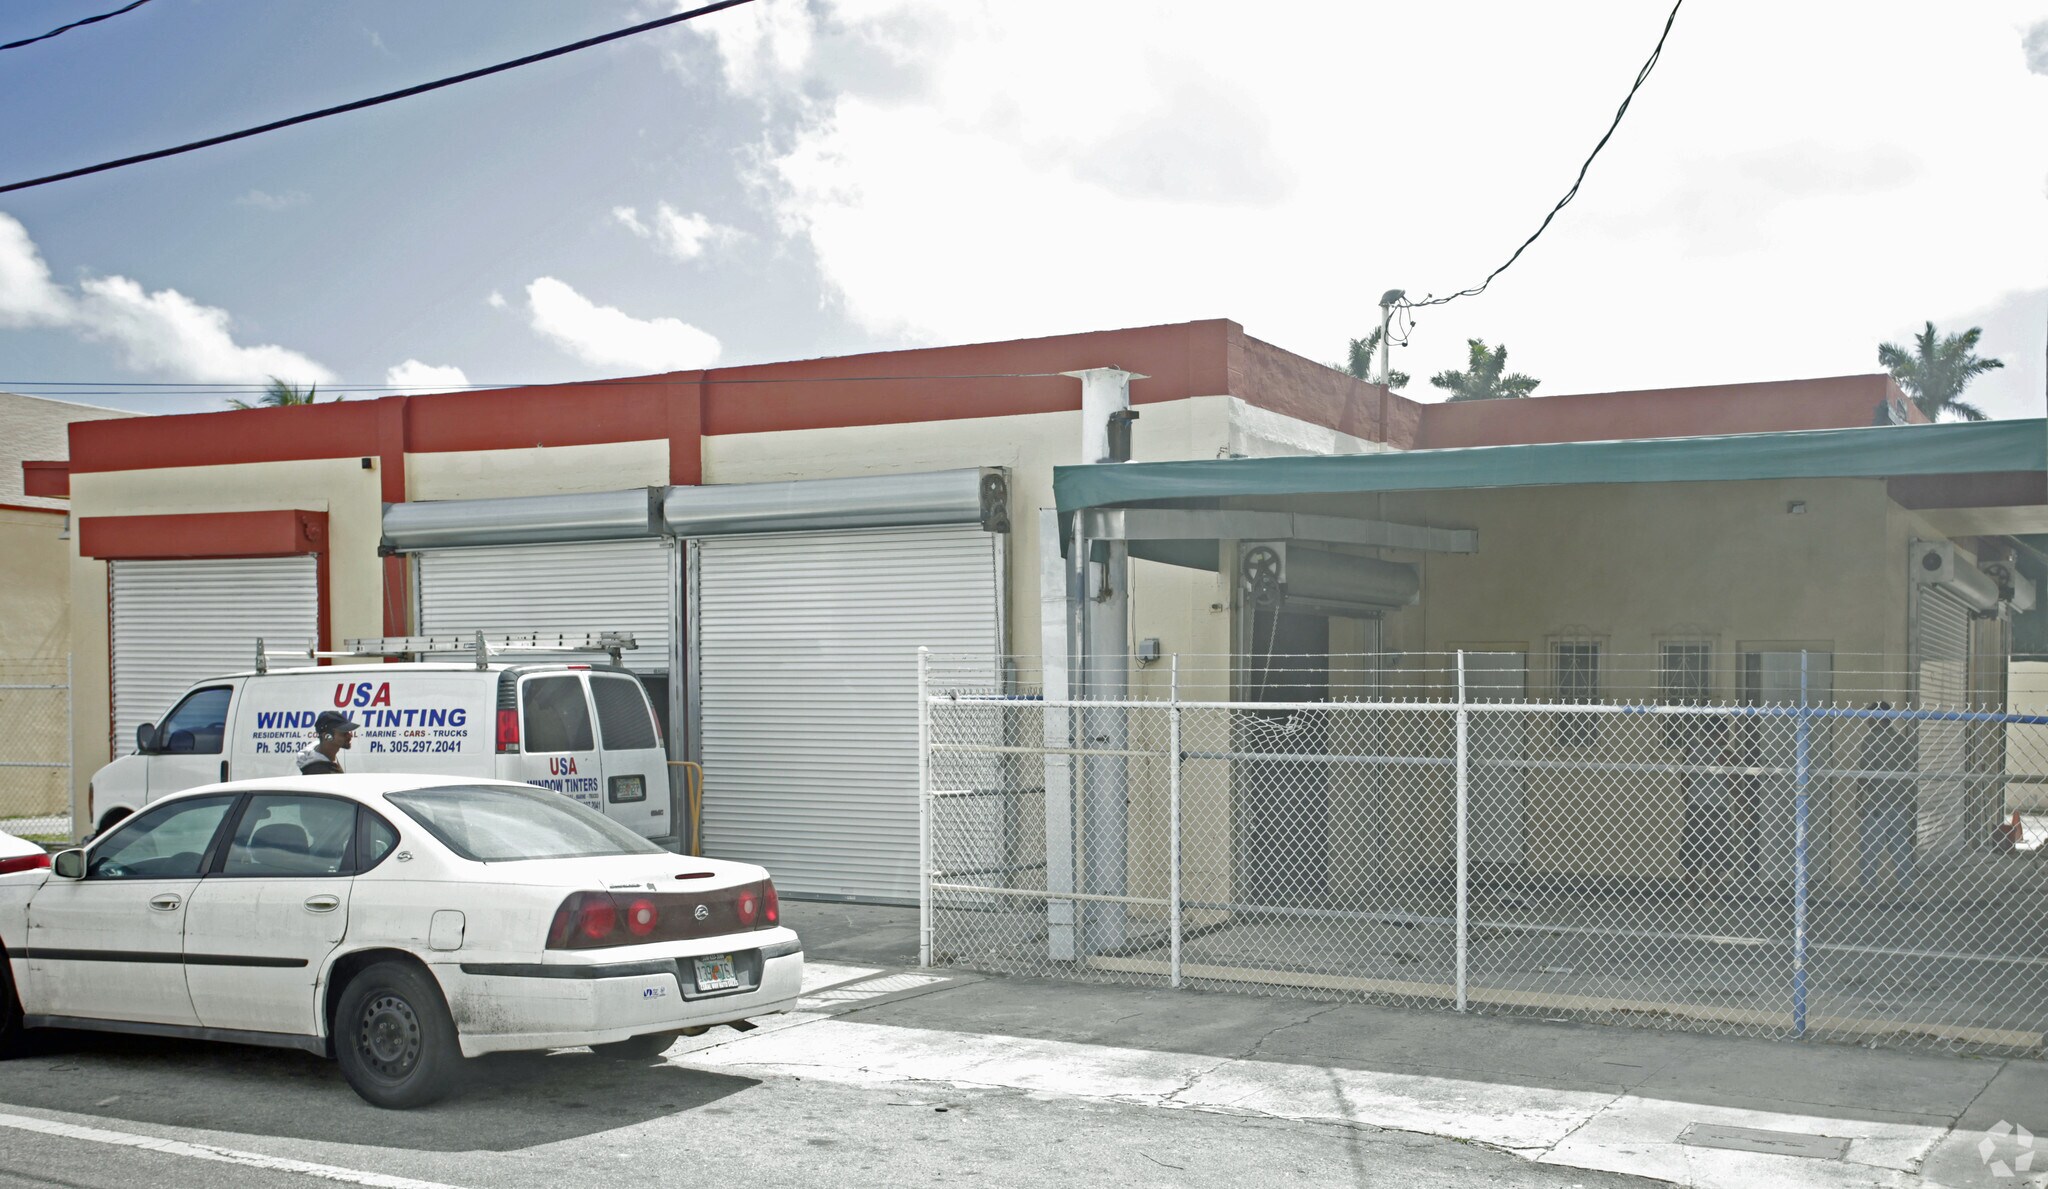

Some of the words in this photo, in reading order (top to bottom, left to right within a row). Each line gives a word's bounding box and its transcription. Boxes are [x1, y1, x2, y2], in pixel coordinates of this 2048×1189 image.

[333, 681, 391, 708] USA
[257, 709, 355, 729] WIND
[362, 708, 467, 728] TINTING
[252, 731, 301, 739] RESIDENTIAL
[433, 729, 468, 737] TRUCKS
[256, 741, 271, 753] Ph.
[370, 741, 386, 753] Ph.
[389, 740, 461, 753] 305.297.2041
[550, 756, 578, 775] USA
[527, 779, 563, 793] NDOW
[565, 777, 598, 792] TINTERS
